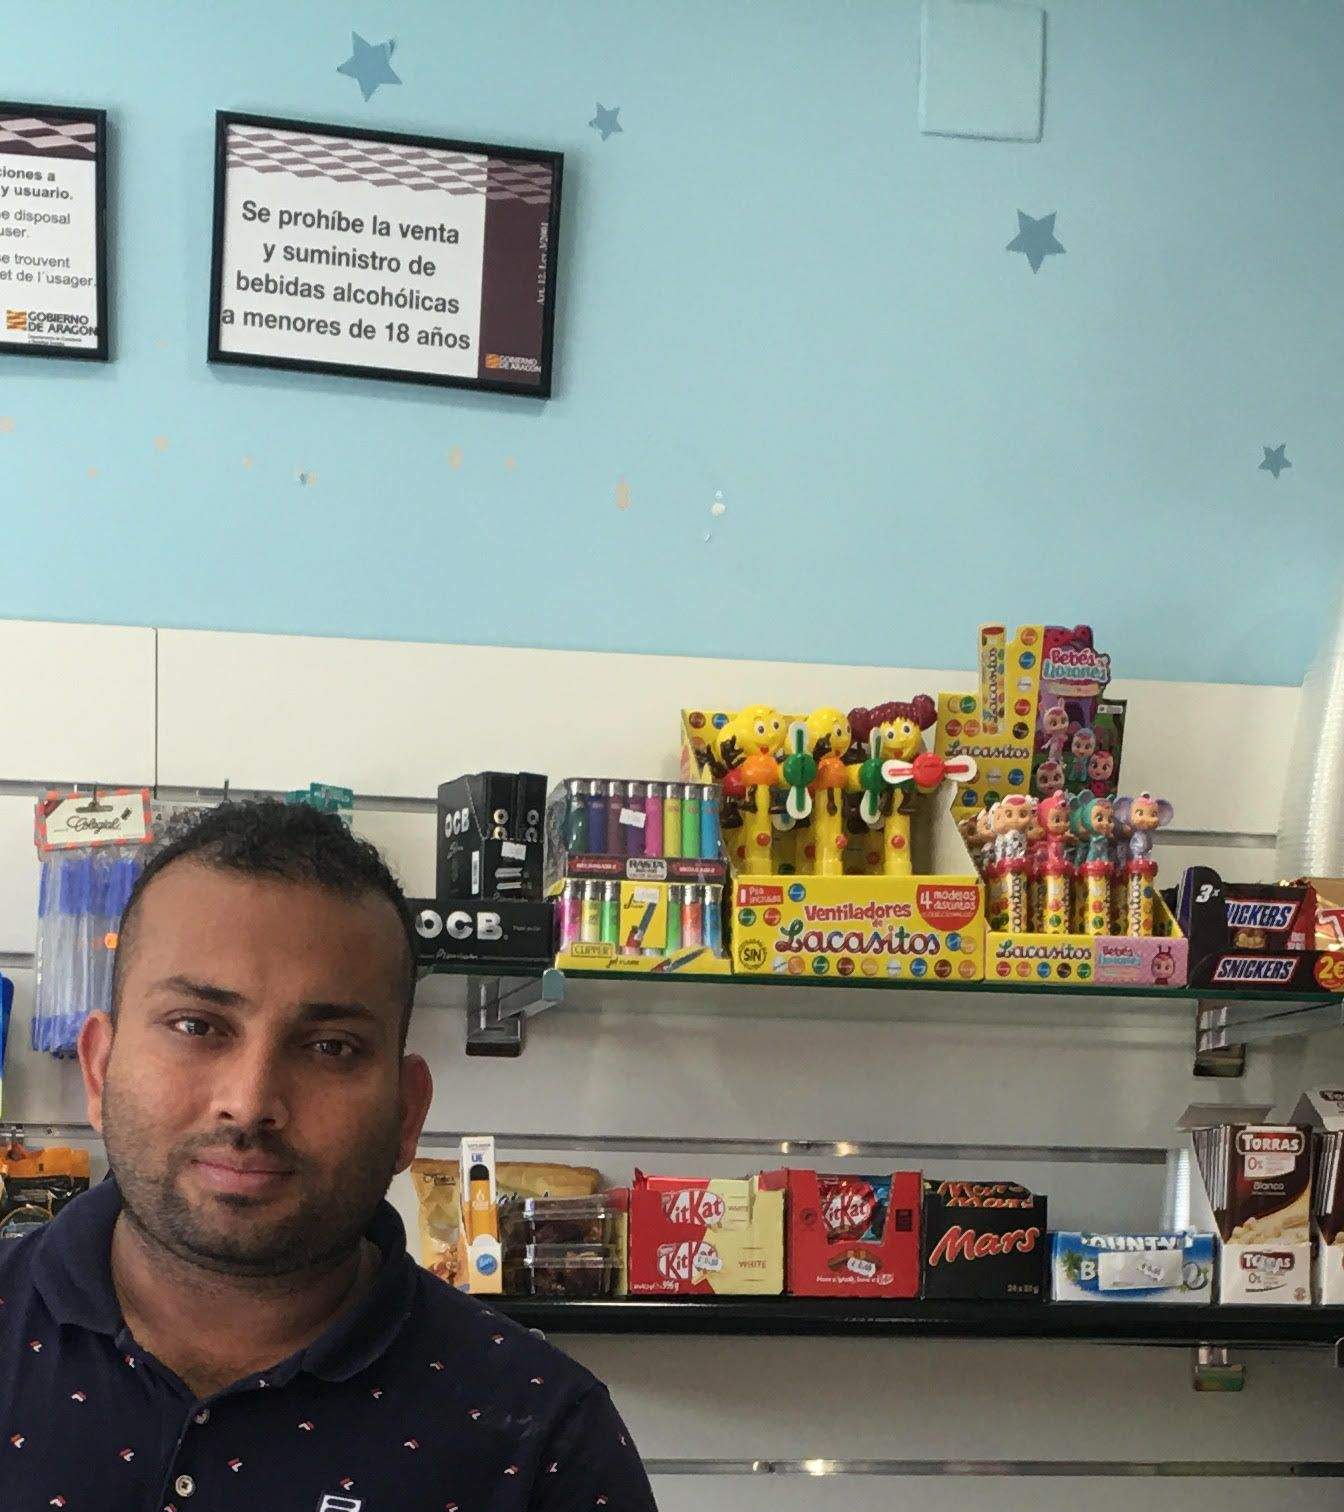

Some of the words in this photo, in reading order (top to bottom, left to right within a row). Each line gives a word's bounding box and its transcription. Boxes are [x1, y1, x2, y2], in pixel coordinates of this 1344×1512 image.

[46, 172, 56, 182] a
[1, 184, 10, 198] y
[14, 184, 74, 200] usuario.
[14, 209, 71, 226] disposal
[242, 200, 271, 222] Se
[278, 207, 365, 233] prohíbe
[373, 215, 391, 237] la
[399, 222, 460, 244] venta
[14, 252, 71, 269] trouvent
[263, 242, 276, 263] y
[283, 242, 401, 273] suministro
[408, 254, 436, 276] de
[0, 269, 13, 281] et
[16, 269, 33, 283] de
[236, 270, 325, 299] bebidas
[333, 278, 460, 314] alcohólicas
[28, 311, 89, 325] GOBIERNO
[28, 322, 44, 332] DE
[221, 309, 235, 325] a
[243, 310, 342, 337] menores
[349, 319, 377, 339] de
[385, 323, 410, 343] 18
[417, 327, 471, 349] años
[1049, 648, 1096, 668] Bebés
[944, 741, 1031, 761] Lacasitos
[445, 807, 470, 839] OCB
[919, 892, 933, 910] 4
[805, 902, 912, 922] Ventiladores
[415, 909, 504, 941] OCB
[774, 919, 941, 955] Lacasitos
[742, 948, 763, 962] SIN
[996, 938, 1093, 961] Lacasitos
[1216, 957, 1297, 981] SNICKERS
[1242, 1133, 1300, 1151] TORRAS
[929, 1226, 1040, 1267] Mars
